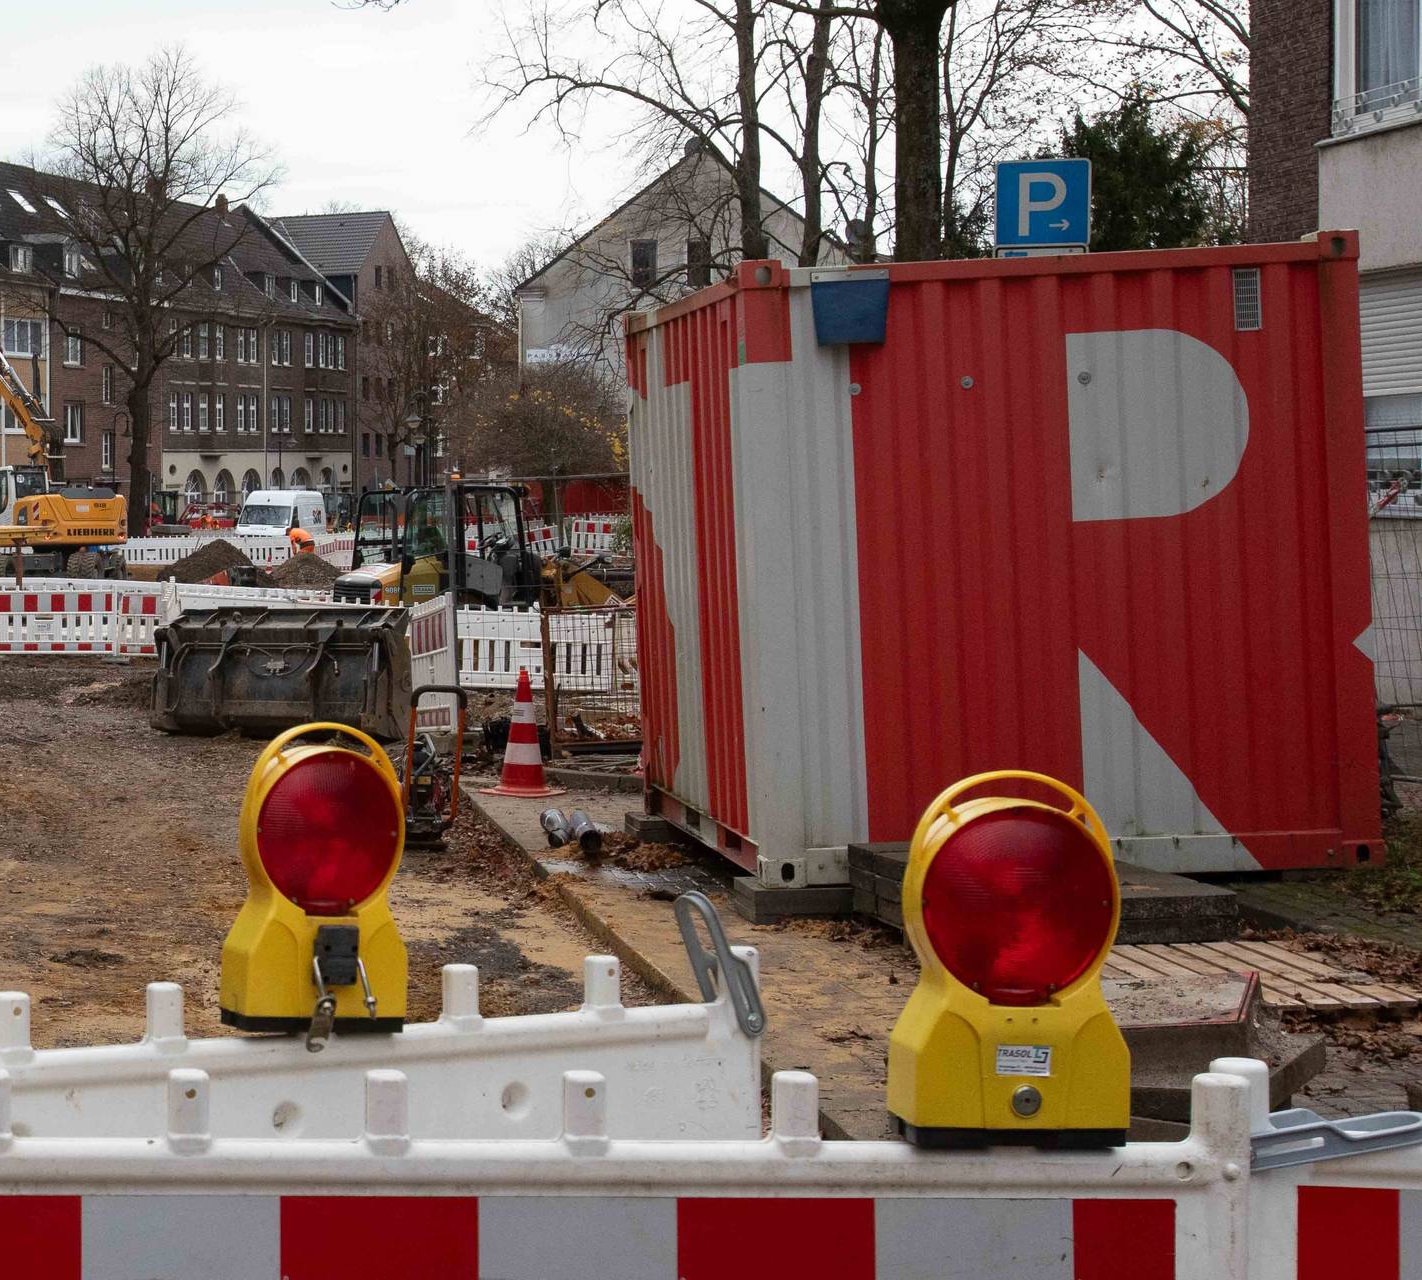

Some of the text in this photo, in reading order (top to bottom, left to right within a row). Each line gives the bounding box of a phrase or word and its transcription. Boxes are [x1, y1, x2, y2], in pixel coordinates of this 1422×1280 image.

[1018, 172, 1067, 237] P
[66, 528, 115, 537] LIEBHERR
[998, 1048, 1033, 1059] TRASOL
